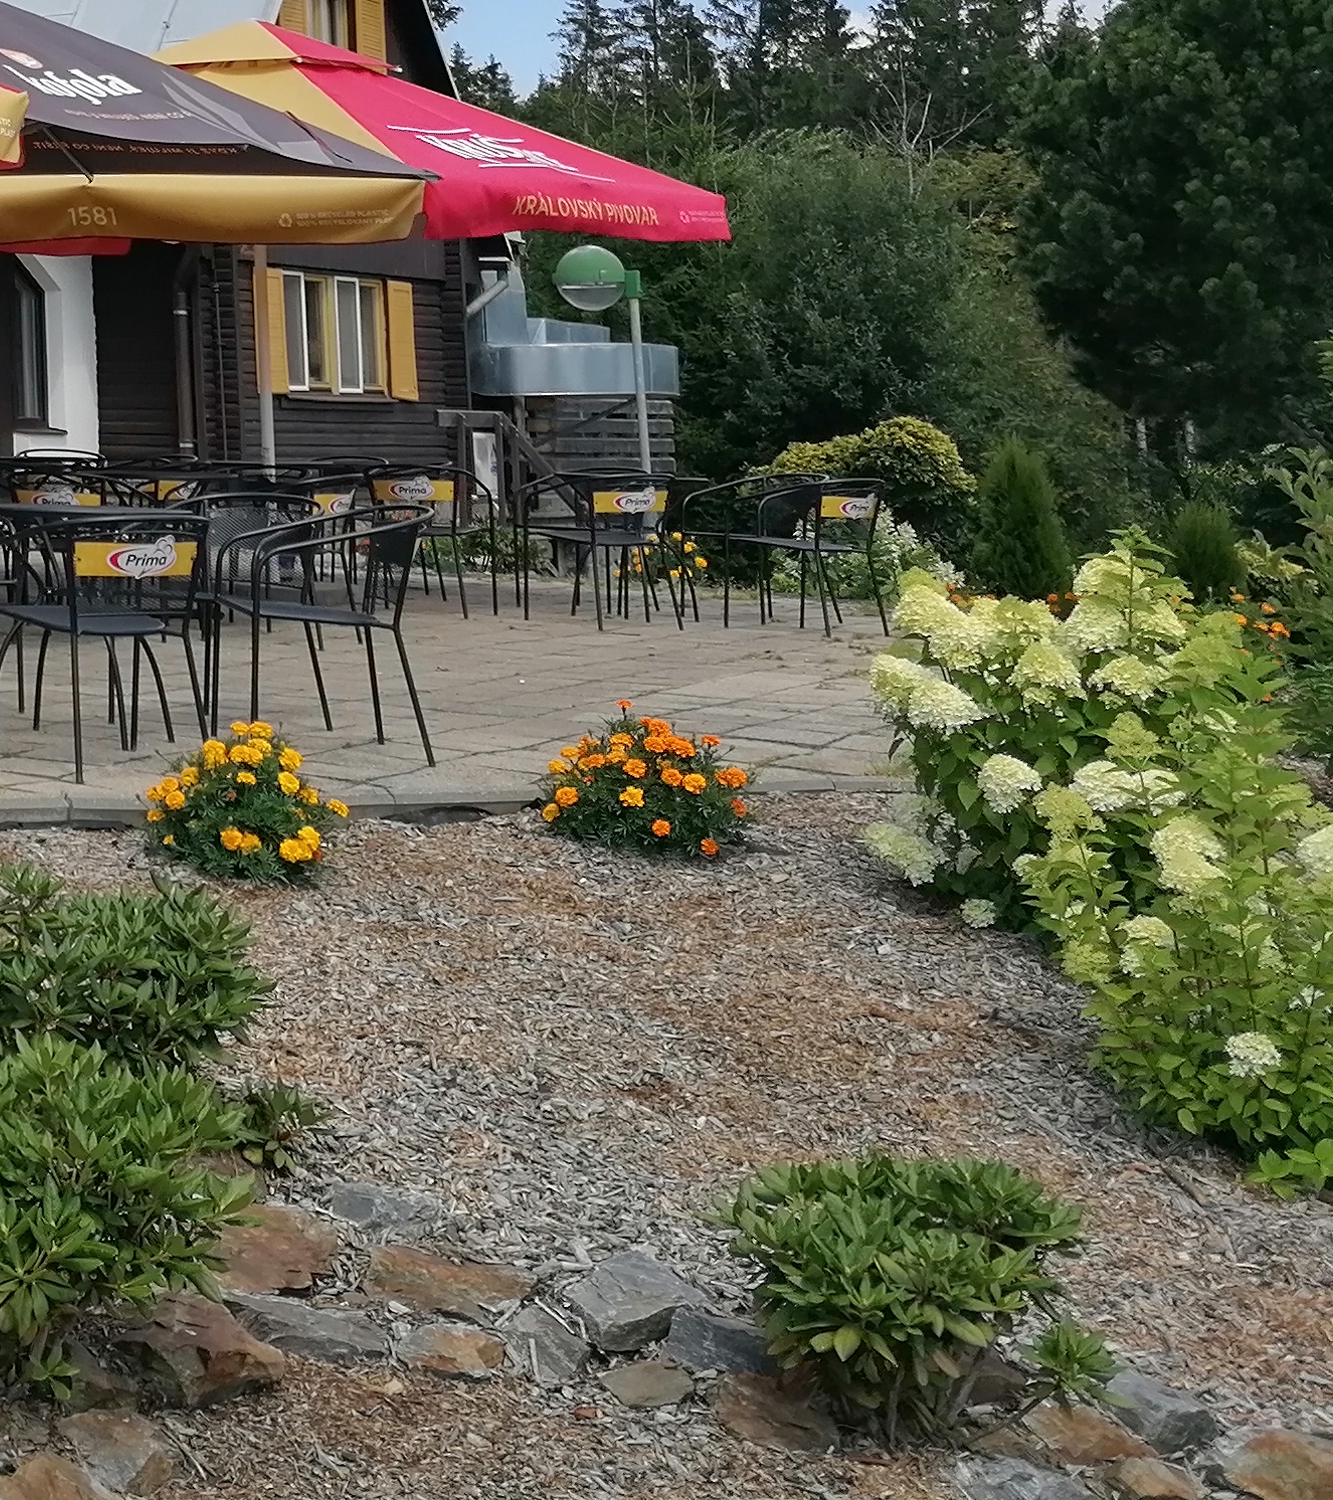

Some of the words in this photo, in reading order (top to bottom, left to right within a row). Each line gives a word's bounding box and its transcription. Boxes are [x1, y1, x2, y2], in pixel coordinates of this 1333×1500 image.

[67, 205, 118, 226] 1581
[512, 191, 603, 221] KRÁLOVSKÝ
[603, 202, 660, 226] PIVOVAR
[398, 486, 427, 495] Prima
[125, 554, 167, 567] Prima
